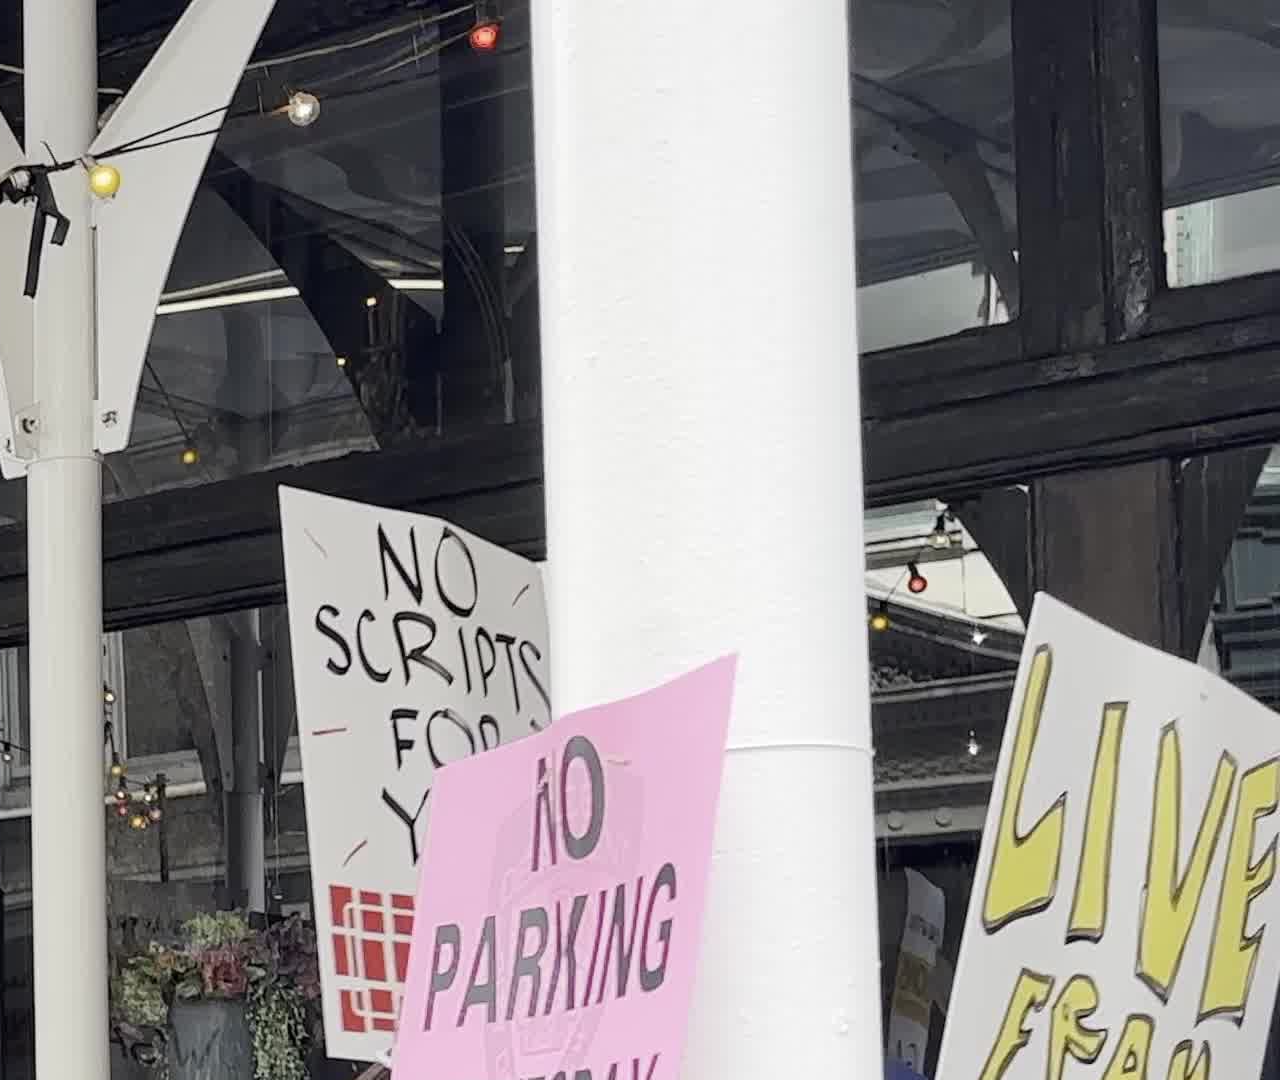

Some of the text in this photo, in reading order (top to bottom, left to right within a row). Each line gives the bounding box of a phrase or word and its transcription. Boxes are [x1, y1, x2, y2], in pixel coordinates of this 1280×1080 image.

[378, 523, 477, 618] NO
[316, 604, 553, 732] SCRIPTS
[531, 735, 605, 871] NO
[982, 643, 1280, 1027] LIVE
[424, 862, 677, 1032] PARKING
